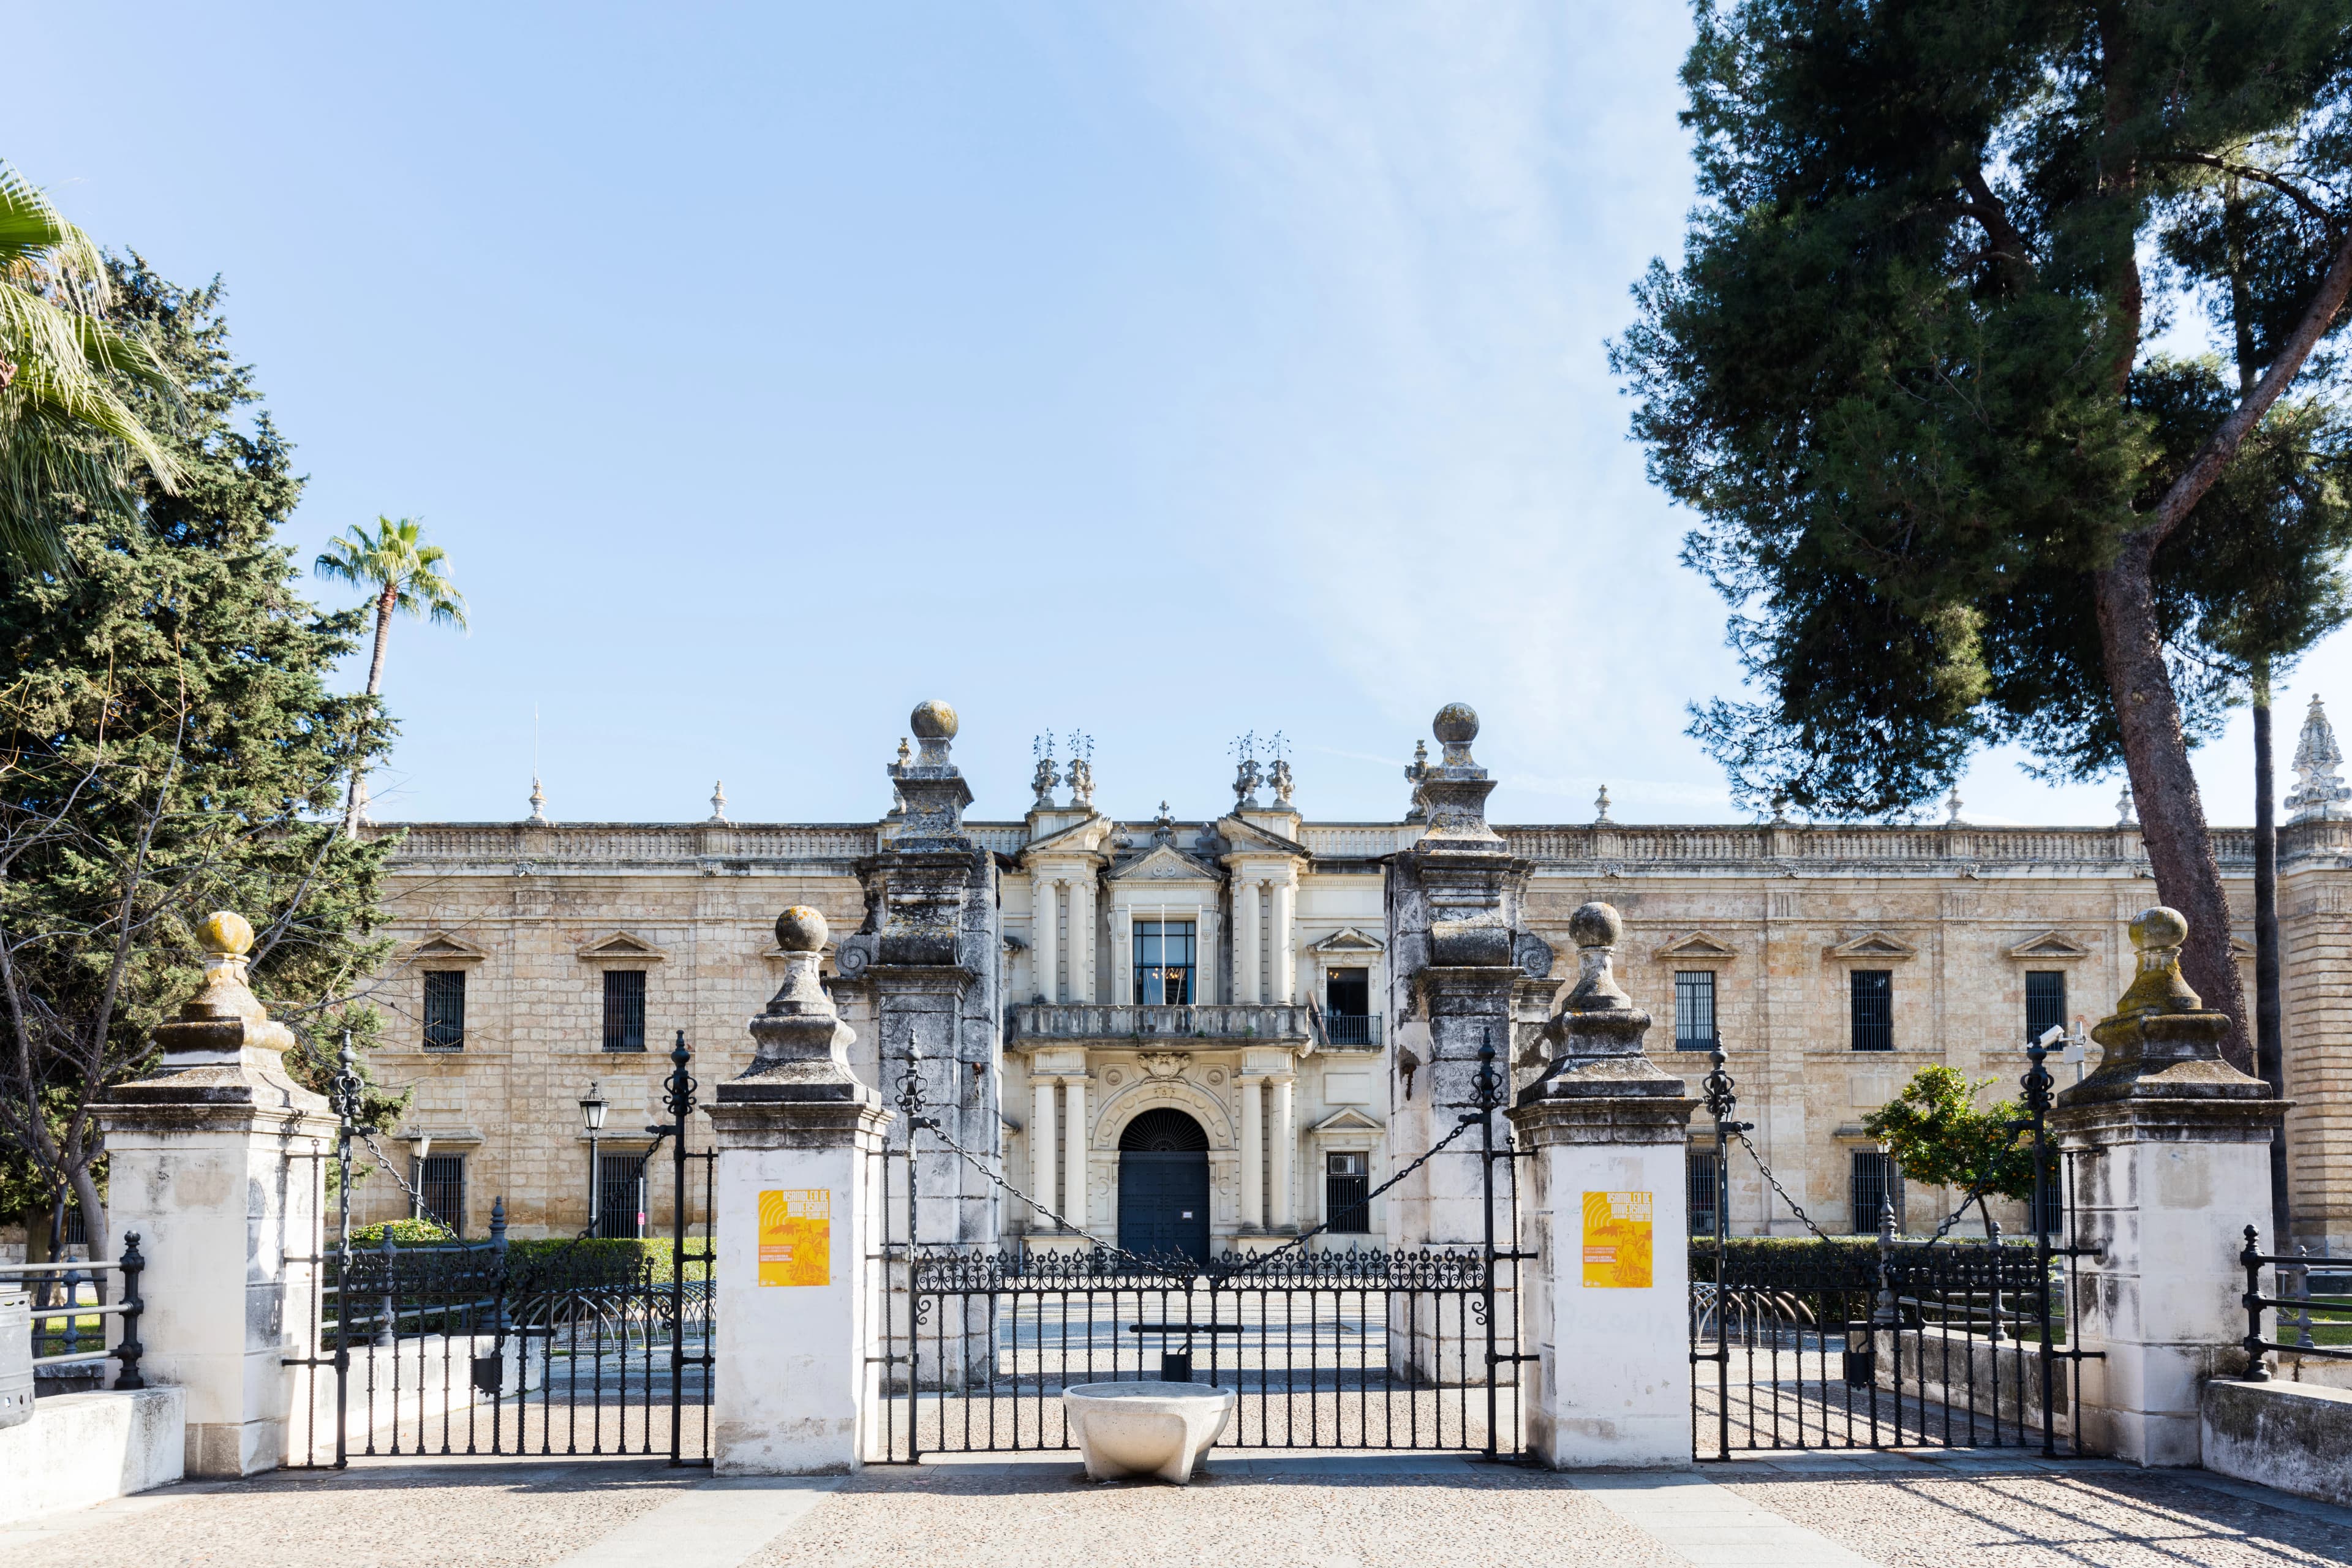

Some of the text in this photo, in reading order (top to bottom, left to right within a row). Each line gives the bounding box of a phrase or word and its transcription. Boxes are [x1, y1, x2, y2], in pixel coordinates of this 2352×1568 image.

[783, 1191, 829, 1201] ASAMBLEA DE
[1607, 1193, 1651, 1204] ASAMBLEA DE
[788, 1201, 829, 1212] UNIVERSIDAD
[1611, 1204, 1651, 1214] UNIVERSIDAD
